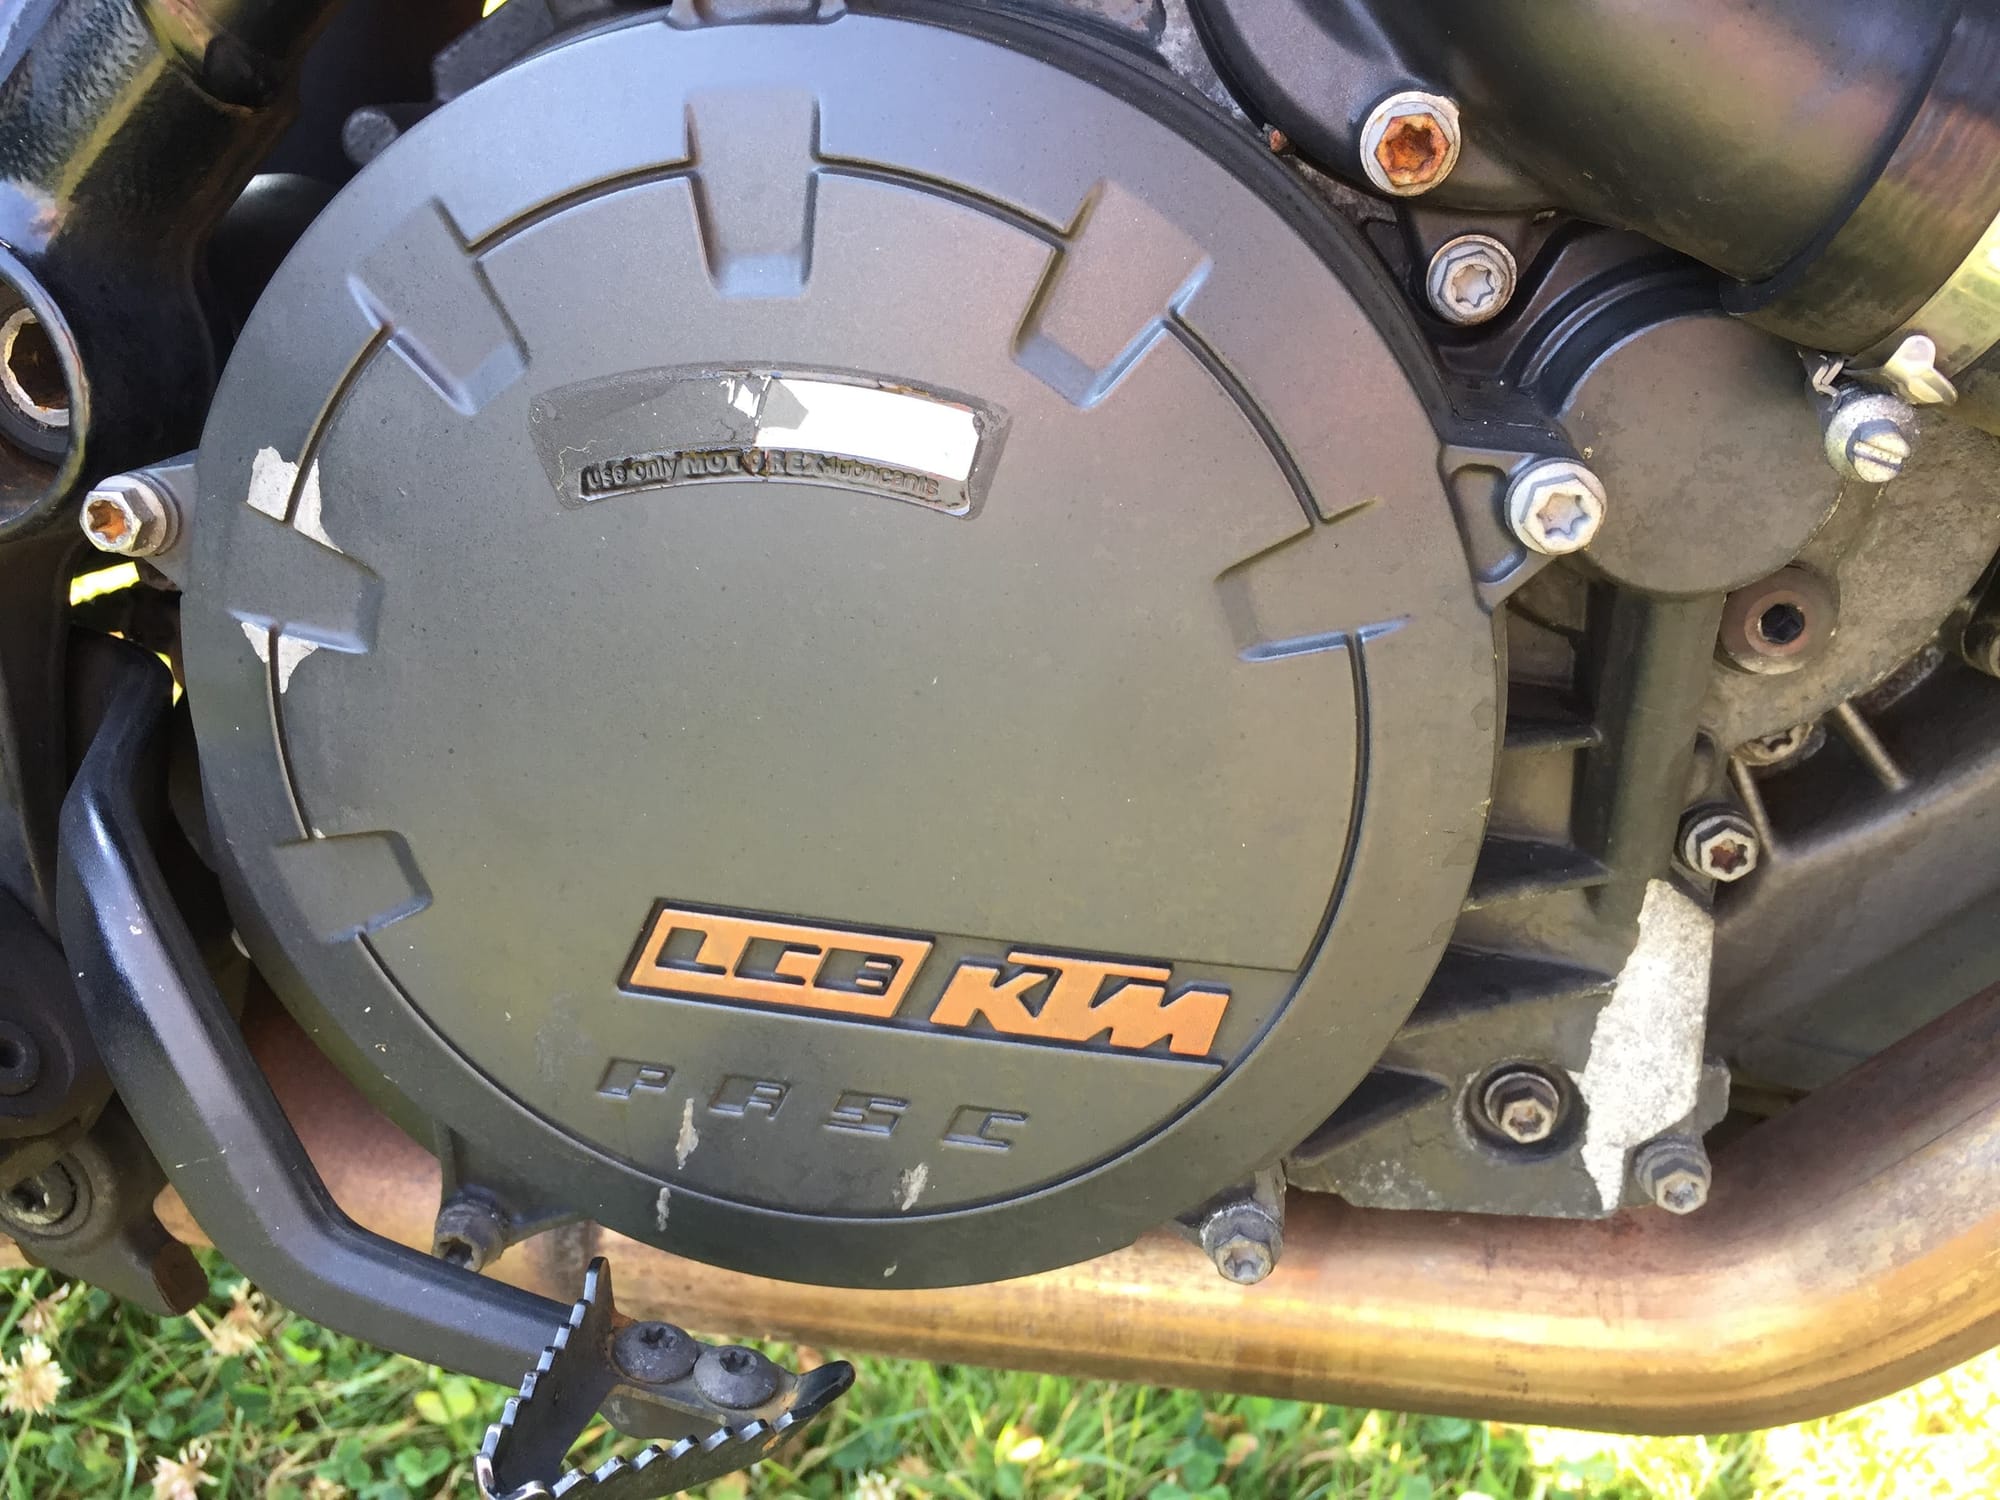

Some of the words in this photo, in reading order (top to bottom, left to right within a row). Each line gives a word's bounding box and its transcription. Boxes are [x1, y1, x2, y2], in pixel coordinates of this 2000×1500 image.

[586, 465, 628, 490] use
[631, 456, 679, 481] only
[929, 950, 1230, 1057] KTM
